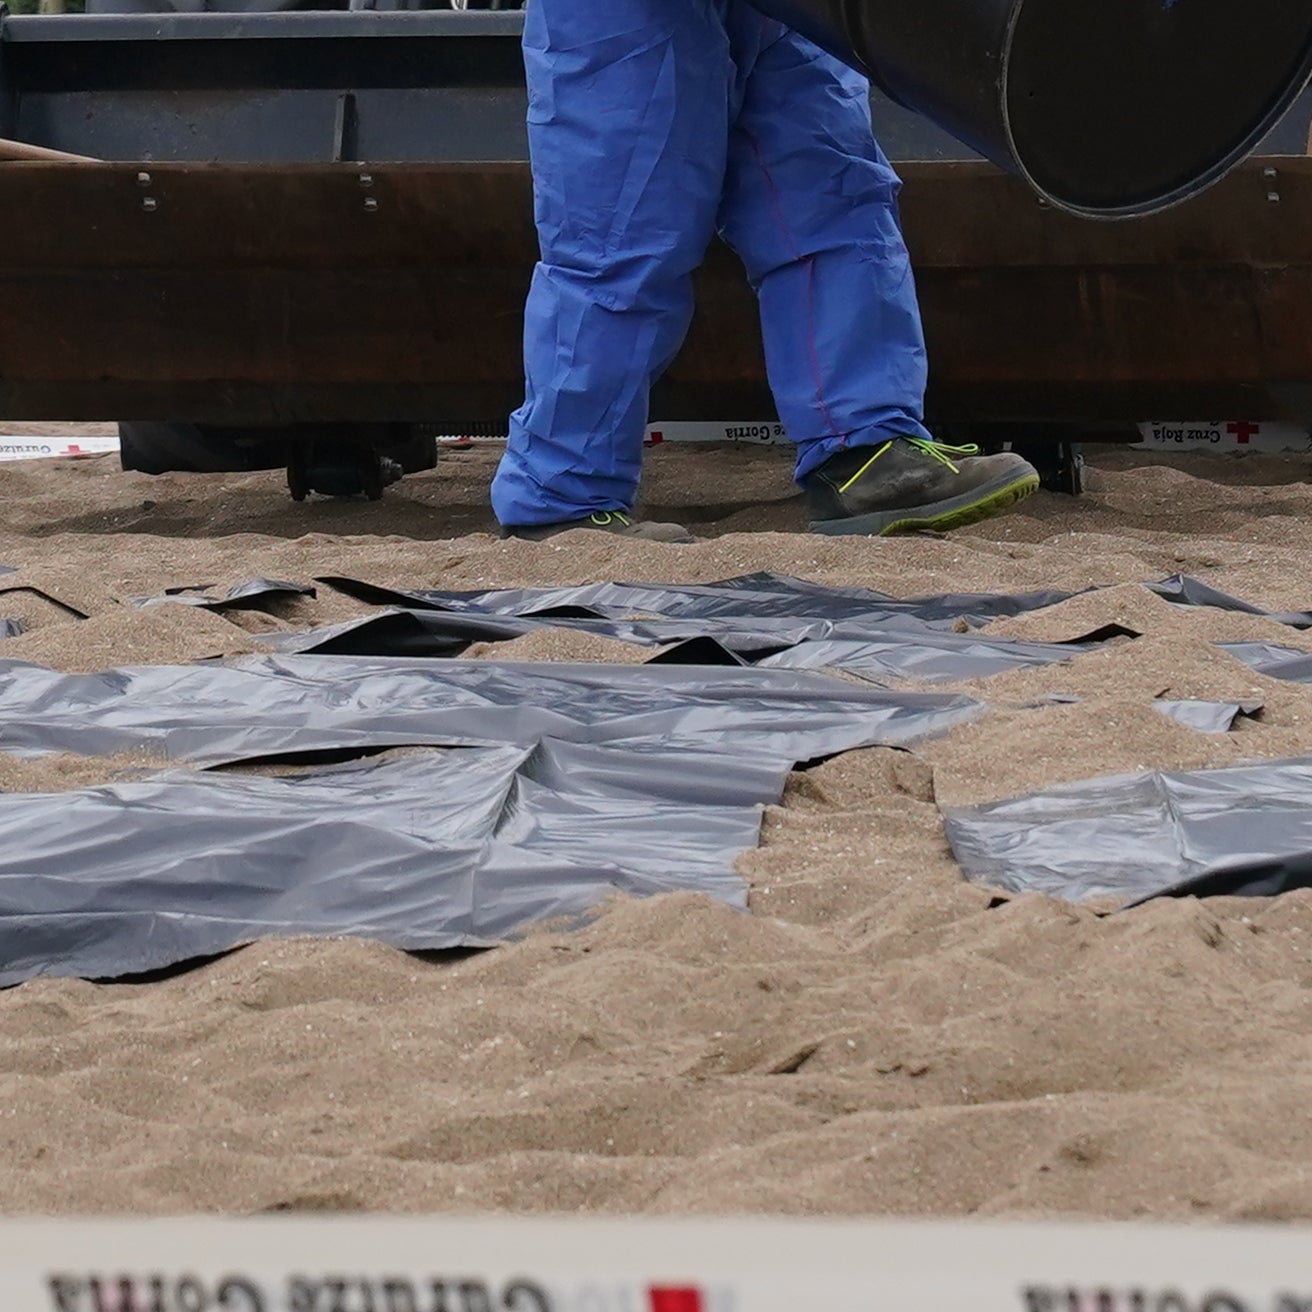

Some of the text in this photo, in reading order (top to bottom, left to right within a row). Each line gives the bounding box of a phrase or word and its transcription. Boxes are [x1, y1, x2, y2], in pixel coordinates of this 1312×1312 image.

[725, 426, 770, 441] Gorria
[1153, 427, 1221, 443] Cruz Roja
